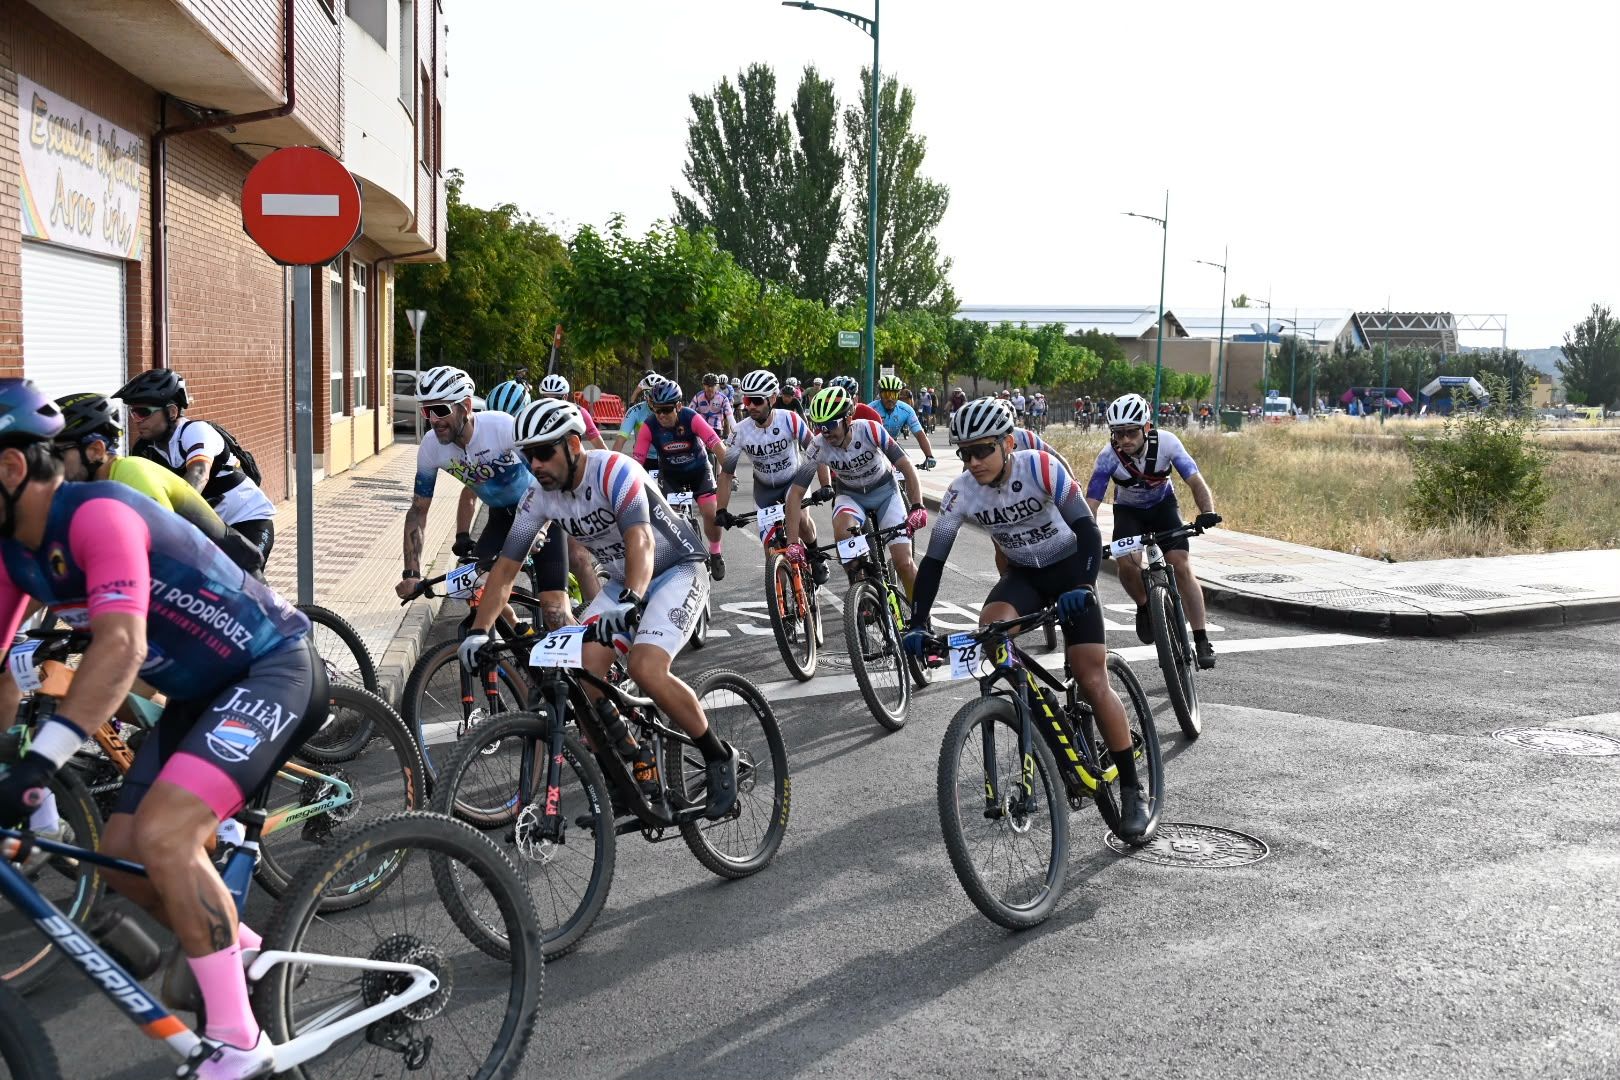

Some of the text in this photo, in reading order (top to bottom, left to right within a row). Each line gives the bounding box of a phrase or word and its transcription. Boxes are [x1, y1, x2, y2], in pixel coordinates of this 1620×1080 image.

[746, 438, 788, 456] MACHO
[830, 450, 874, 471] MACHO
[974, 497, 1043, 526] MACHO
[653, 504, 696, 553] MAGLIA
[848, 540, 856, 549] 6
[1117, 537, 1135, 548] 68
[452, 574, 472, 591] 78
[150, 578, 254, 651] TI RODRÍGUEZ
[544, 634, 573, 650] 37
[637, 629, 664, 637] GLIA
[285, 800, 336, 823] megamo
[34, 914, 155, 1014] BERRIA
